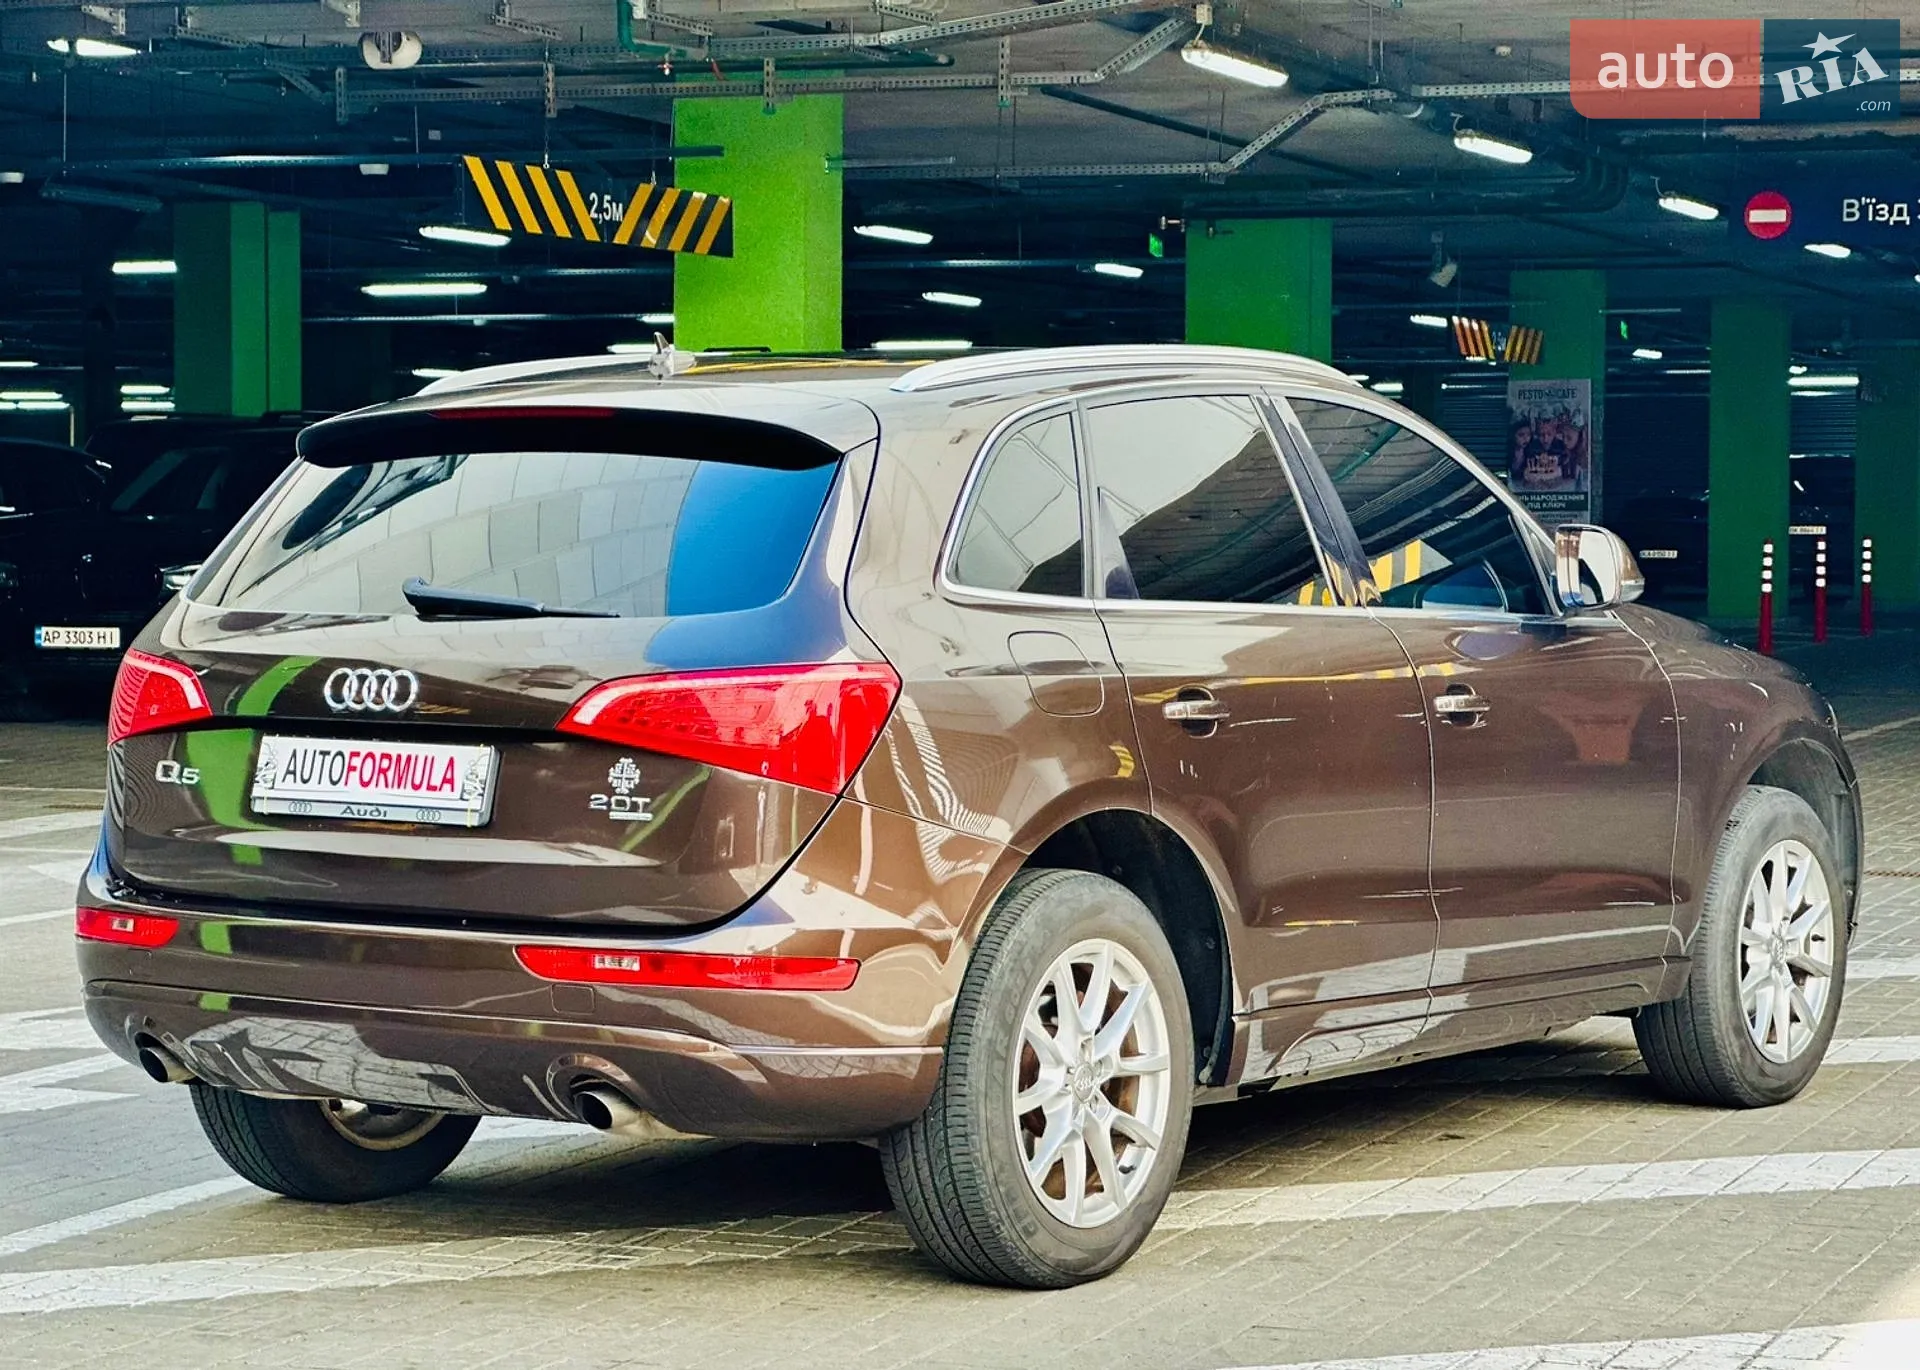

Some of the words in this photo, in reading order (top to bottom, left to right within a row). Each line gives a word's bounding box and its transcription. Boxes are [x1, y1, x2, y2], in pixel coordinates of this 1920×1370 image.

[1842, 196, 1910, 226] В'їзд
[43, 630, 61, 644] AP
[65, 630, 94, 644] 3303
[155, 759, 201, 785] Q5
[282, 748, 455, 793] AUTOFORMULA
[340, 805, 388, 818] Audi
